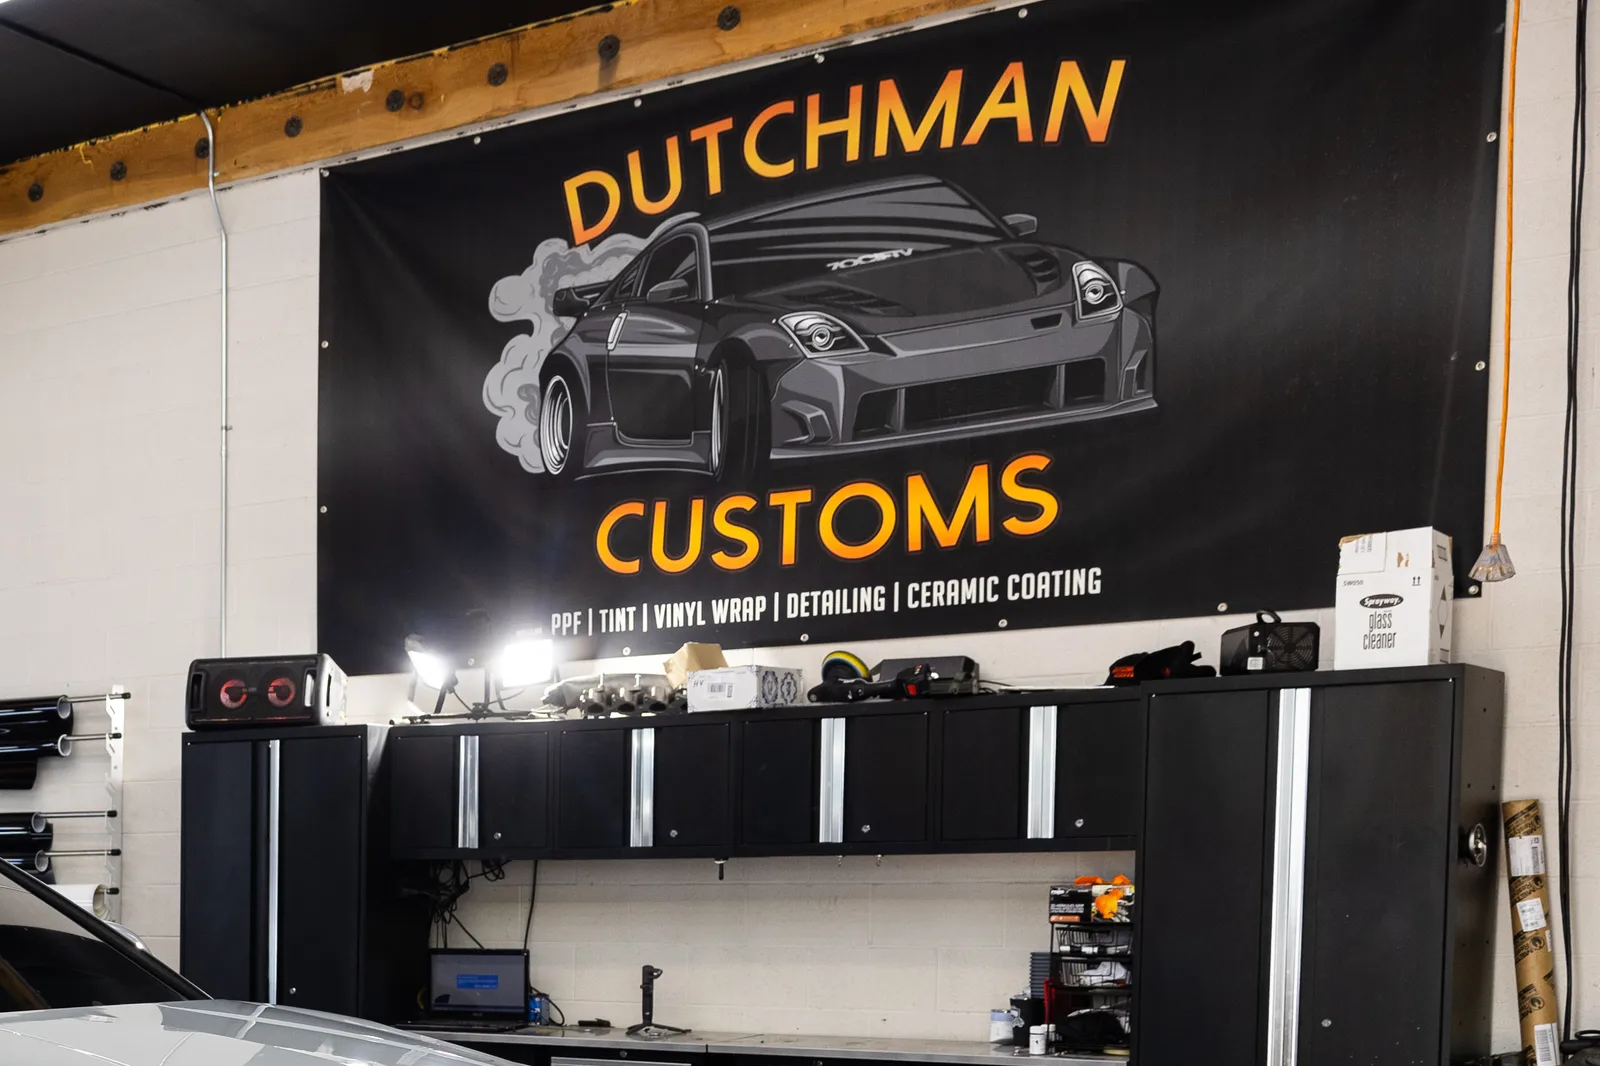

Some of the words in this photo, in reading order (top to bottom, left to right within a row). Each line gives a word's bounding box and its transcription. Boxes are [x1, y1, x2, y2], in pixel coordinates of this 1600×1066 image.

[564, 60, 1126, 246] DUTCHMAN
[596, 454, 1060, 575] CUSTOMS
[551, 611, 582, 636] PPF
[598, 606, 637, 633] TINT
[653, 600, 706, 630] VINYL
[711, 595, 767, 625] WRAP
[786, 585, 886, 619] DETAILING
[907, 575, 999, 609] CERAMIC
[1007, 567, 1102, 601] COATING
[1368, 612, 1393, 632] glass
[1362, 632, 1398, 651] cleaner
